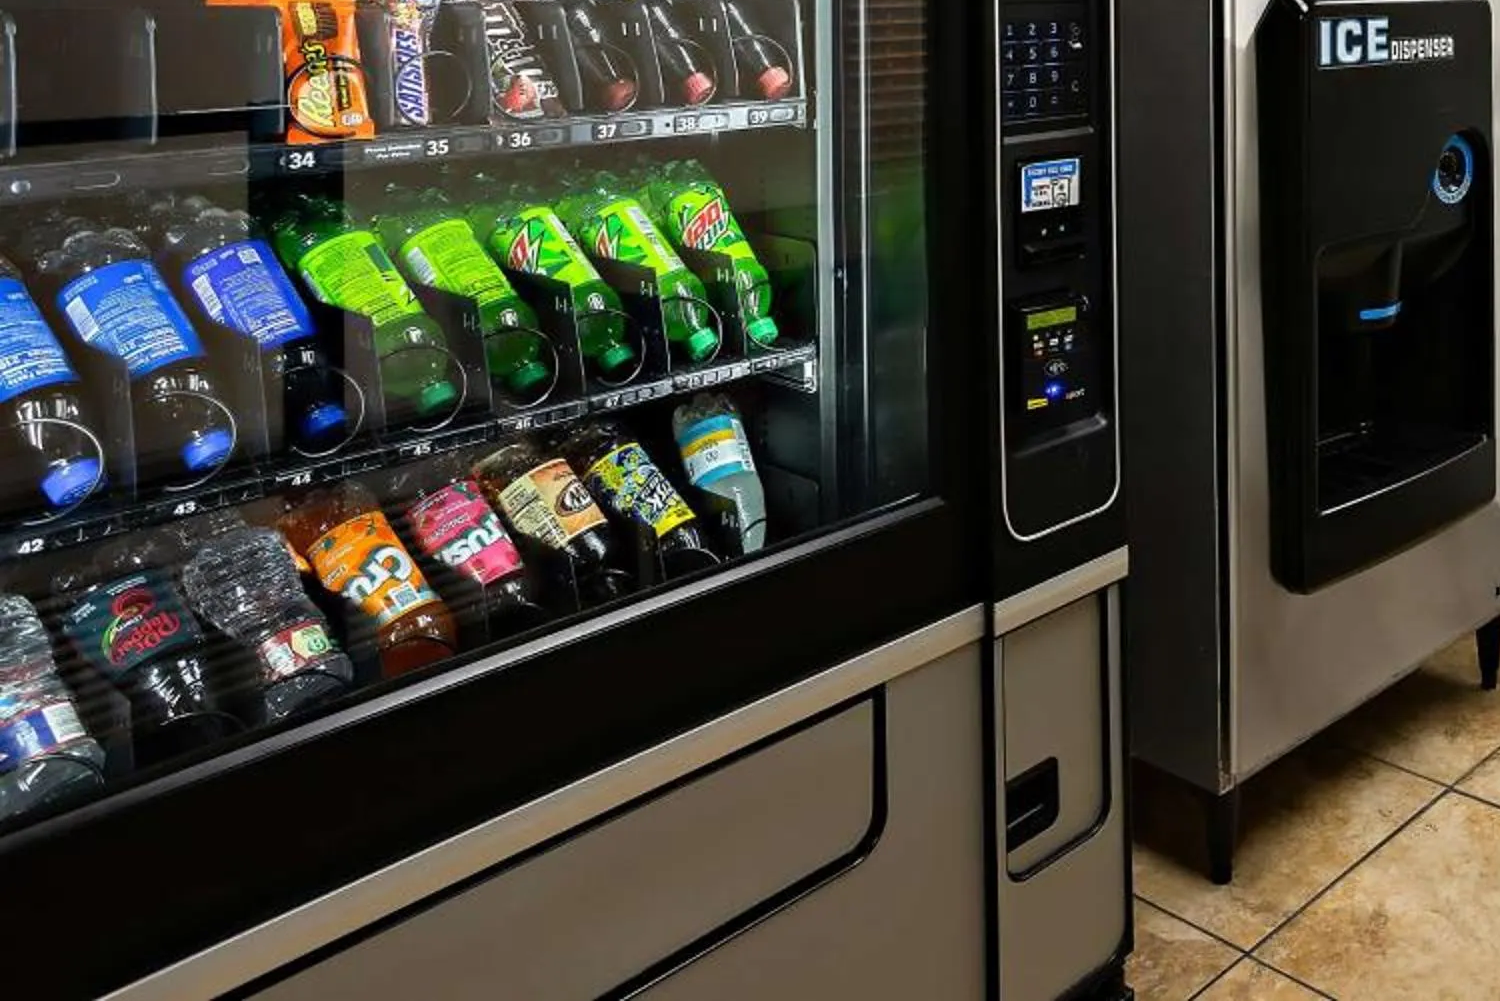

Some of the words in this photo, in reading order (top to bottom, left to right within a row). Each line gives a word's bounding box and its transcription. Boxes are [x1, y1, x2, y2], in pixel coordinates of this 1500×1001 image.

[1320, 19, 1389, 65] ICE
[1391, 37, 1454, 61] DISPENSER
[677, 116, 696, 132] 38
[749, 110, 769, 125] 39
[509, 132, 532, 149] 36
[597, 124, 617, 140] 37
[427, 138, 449, 157] 35
[288, 151, 317, 170] 34
[291, 472, 312, 486] 44
[173, 500, 197, 515] 43
[17, 537, 44, 555] 42
[341, 546, 413, 606] Cru
